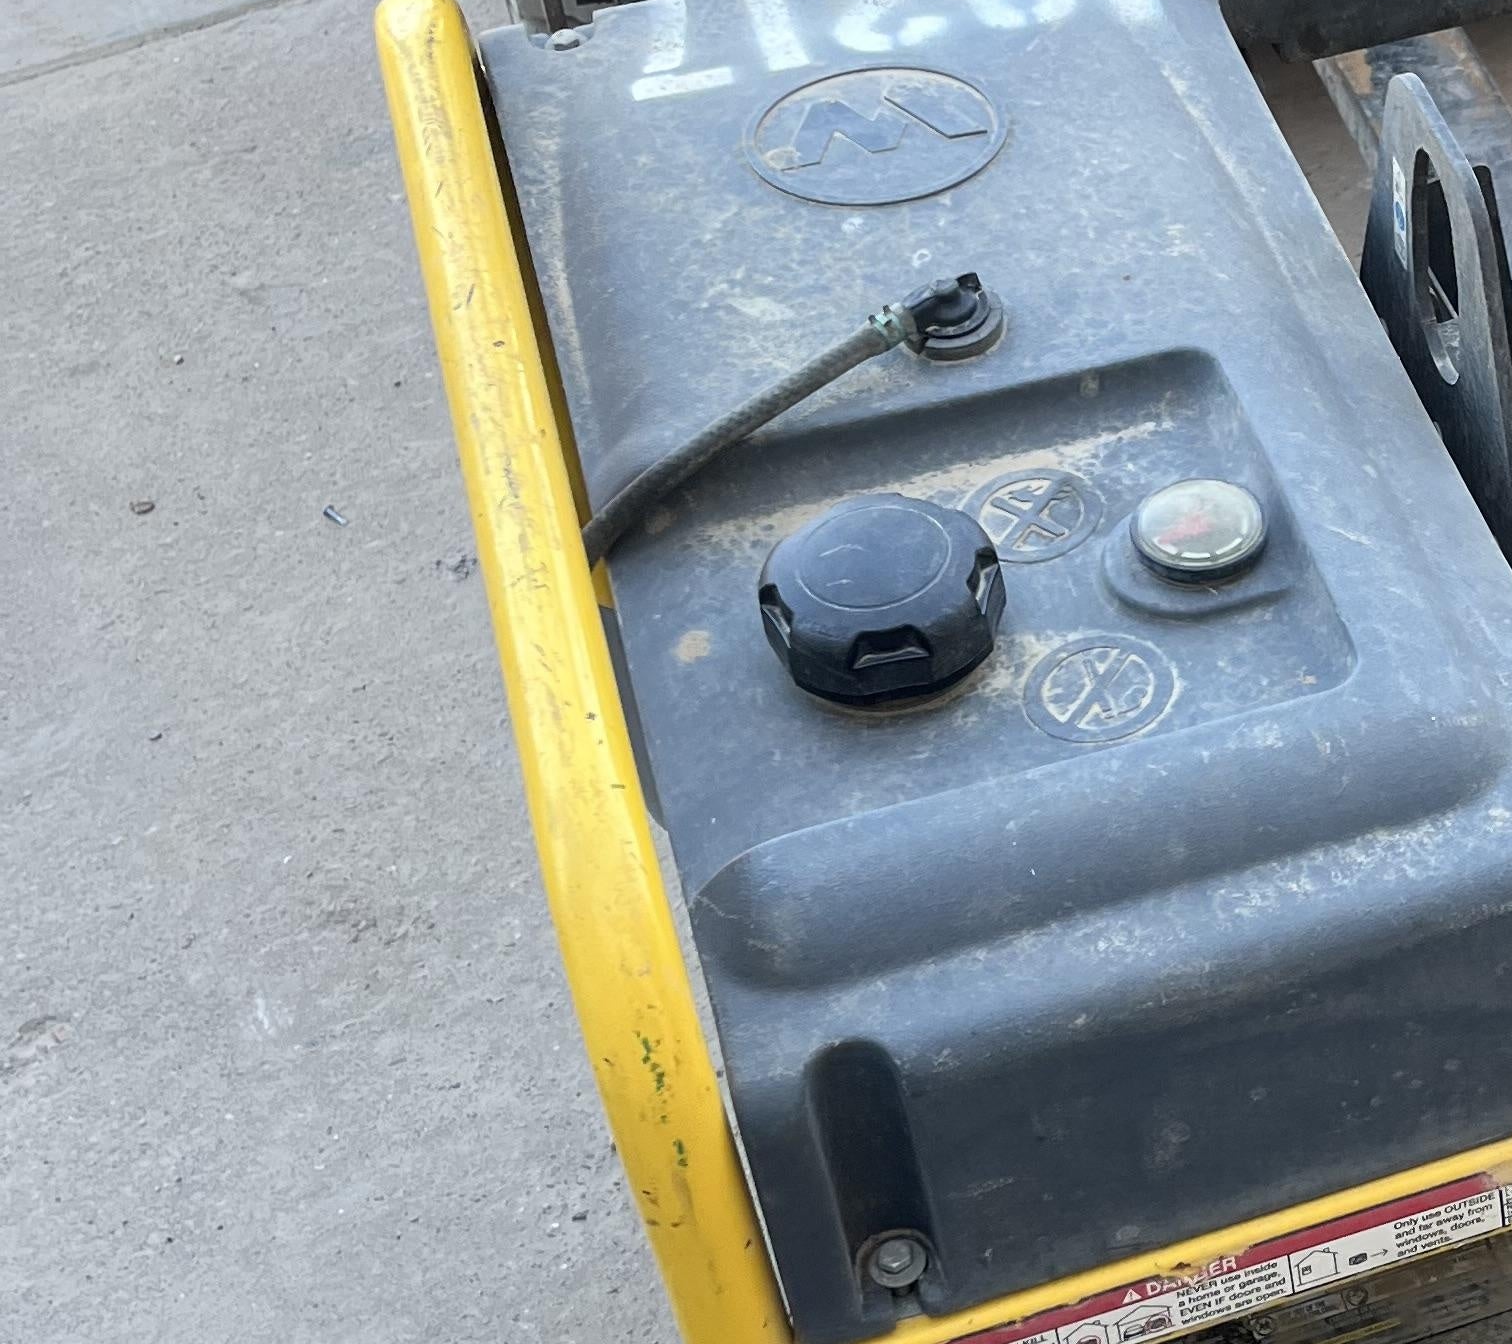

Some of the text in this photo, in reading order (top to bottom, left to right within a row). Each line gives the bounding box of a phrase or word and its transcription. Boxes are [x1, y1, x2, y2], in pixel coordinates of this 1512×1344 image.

[1393, 1216, 1418, 1229] Only
[1422, 1209, 1440, 1220] use
[1444, 1193, 1494, 1212] OUTSIDE
[1394, 1203, 1491, 1238] and far away from
[1396, 1235, 1450, 1255] and vents.
[1175, 1261, 1277, 1296] NEVER use inside
[1179, 1277, 1285, 1315] EVEN IF doors and
[1188, 1288, 1220, 1302] home
[1224, 1283, 1235, 1293] or
[1238, 1271, 1280, 1287] garage,
[1181, 1288, 1285, 1322] windows are open.
